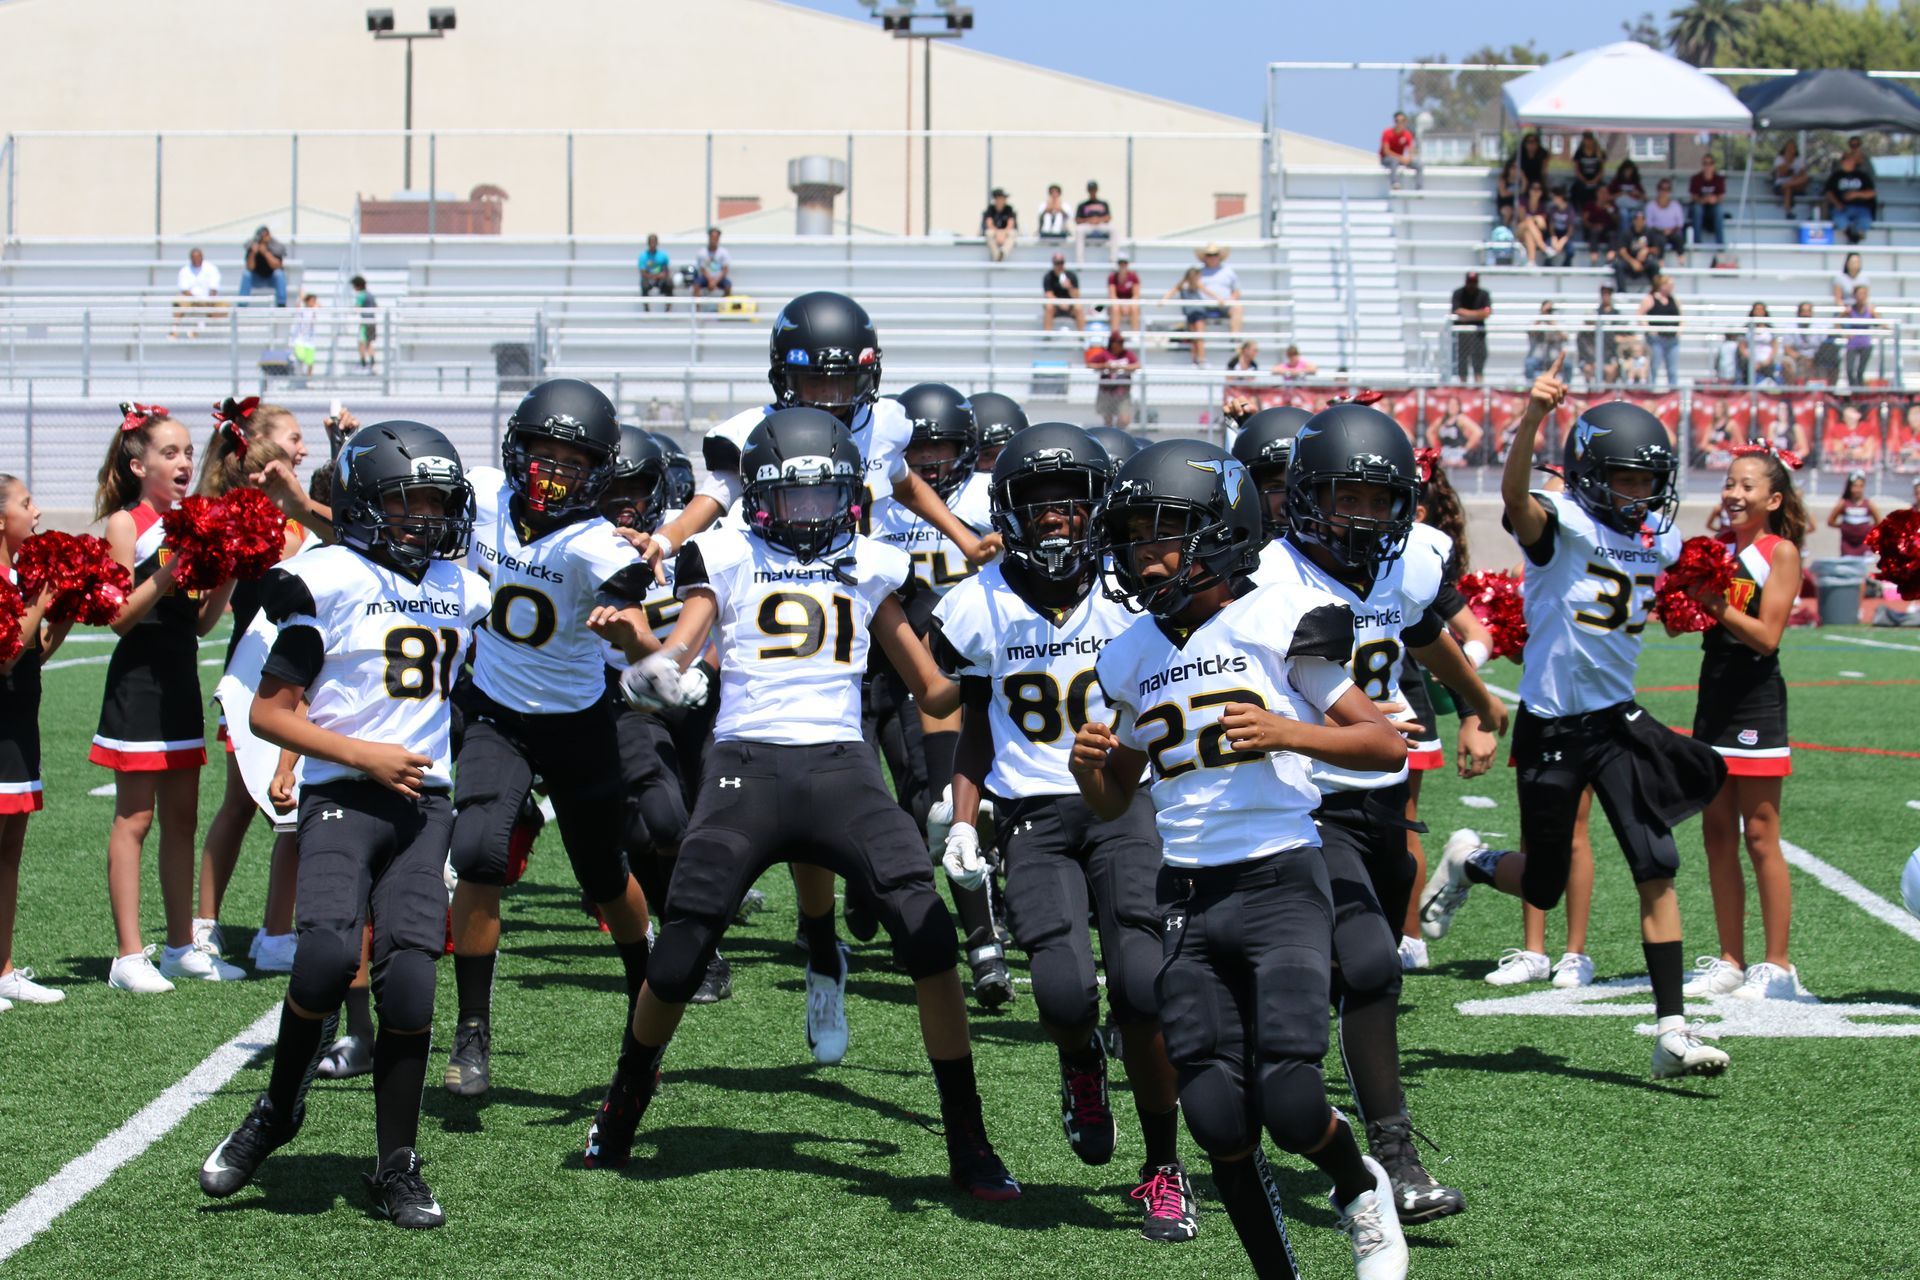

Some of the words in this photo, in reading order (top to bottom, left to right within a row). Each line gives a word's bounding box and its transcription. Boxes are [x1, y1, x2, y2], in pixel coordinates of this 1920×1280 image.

[476, 541, 564, 584] mavericks
[886, 529, 948, 542] maveric
[754, 567, 846, 583] maveric
[366, 597, 460, 617] mavericks
[482, 572, 558, 649] 0
[755, 588, 856, 666] 91
[1354, 608, 1401, 629] ericks
[384, 624, 460, 701] 81
[1139, 654, 1248, 698] mavericks
[1352, 637, 1400, 701] 8
[1002, 667, 1122, 745] 80
[1133, 687, 1270, 782] 22
